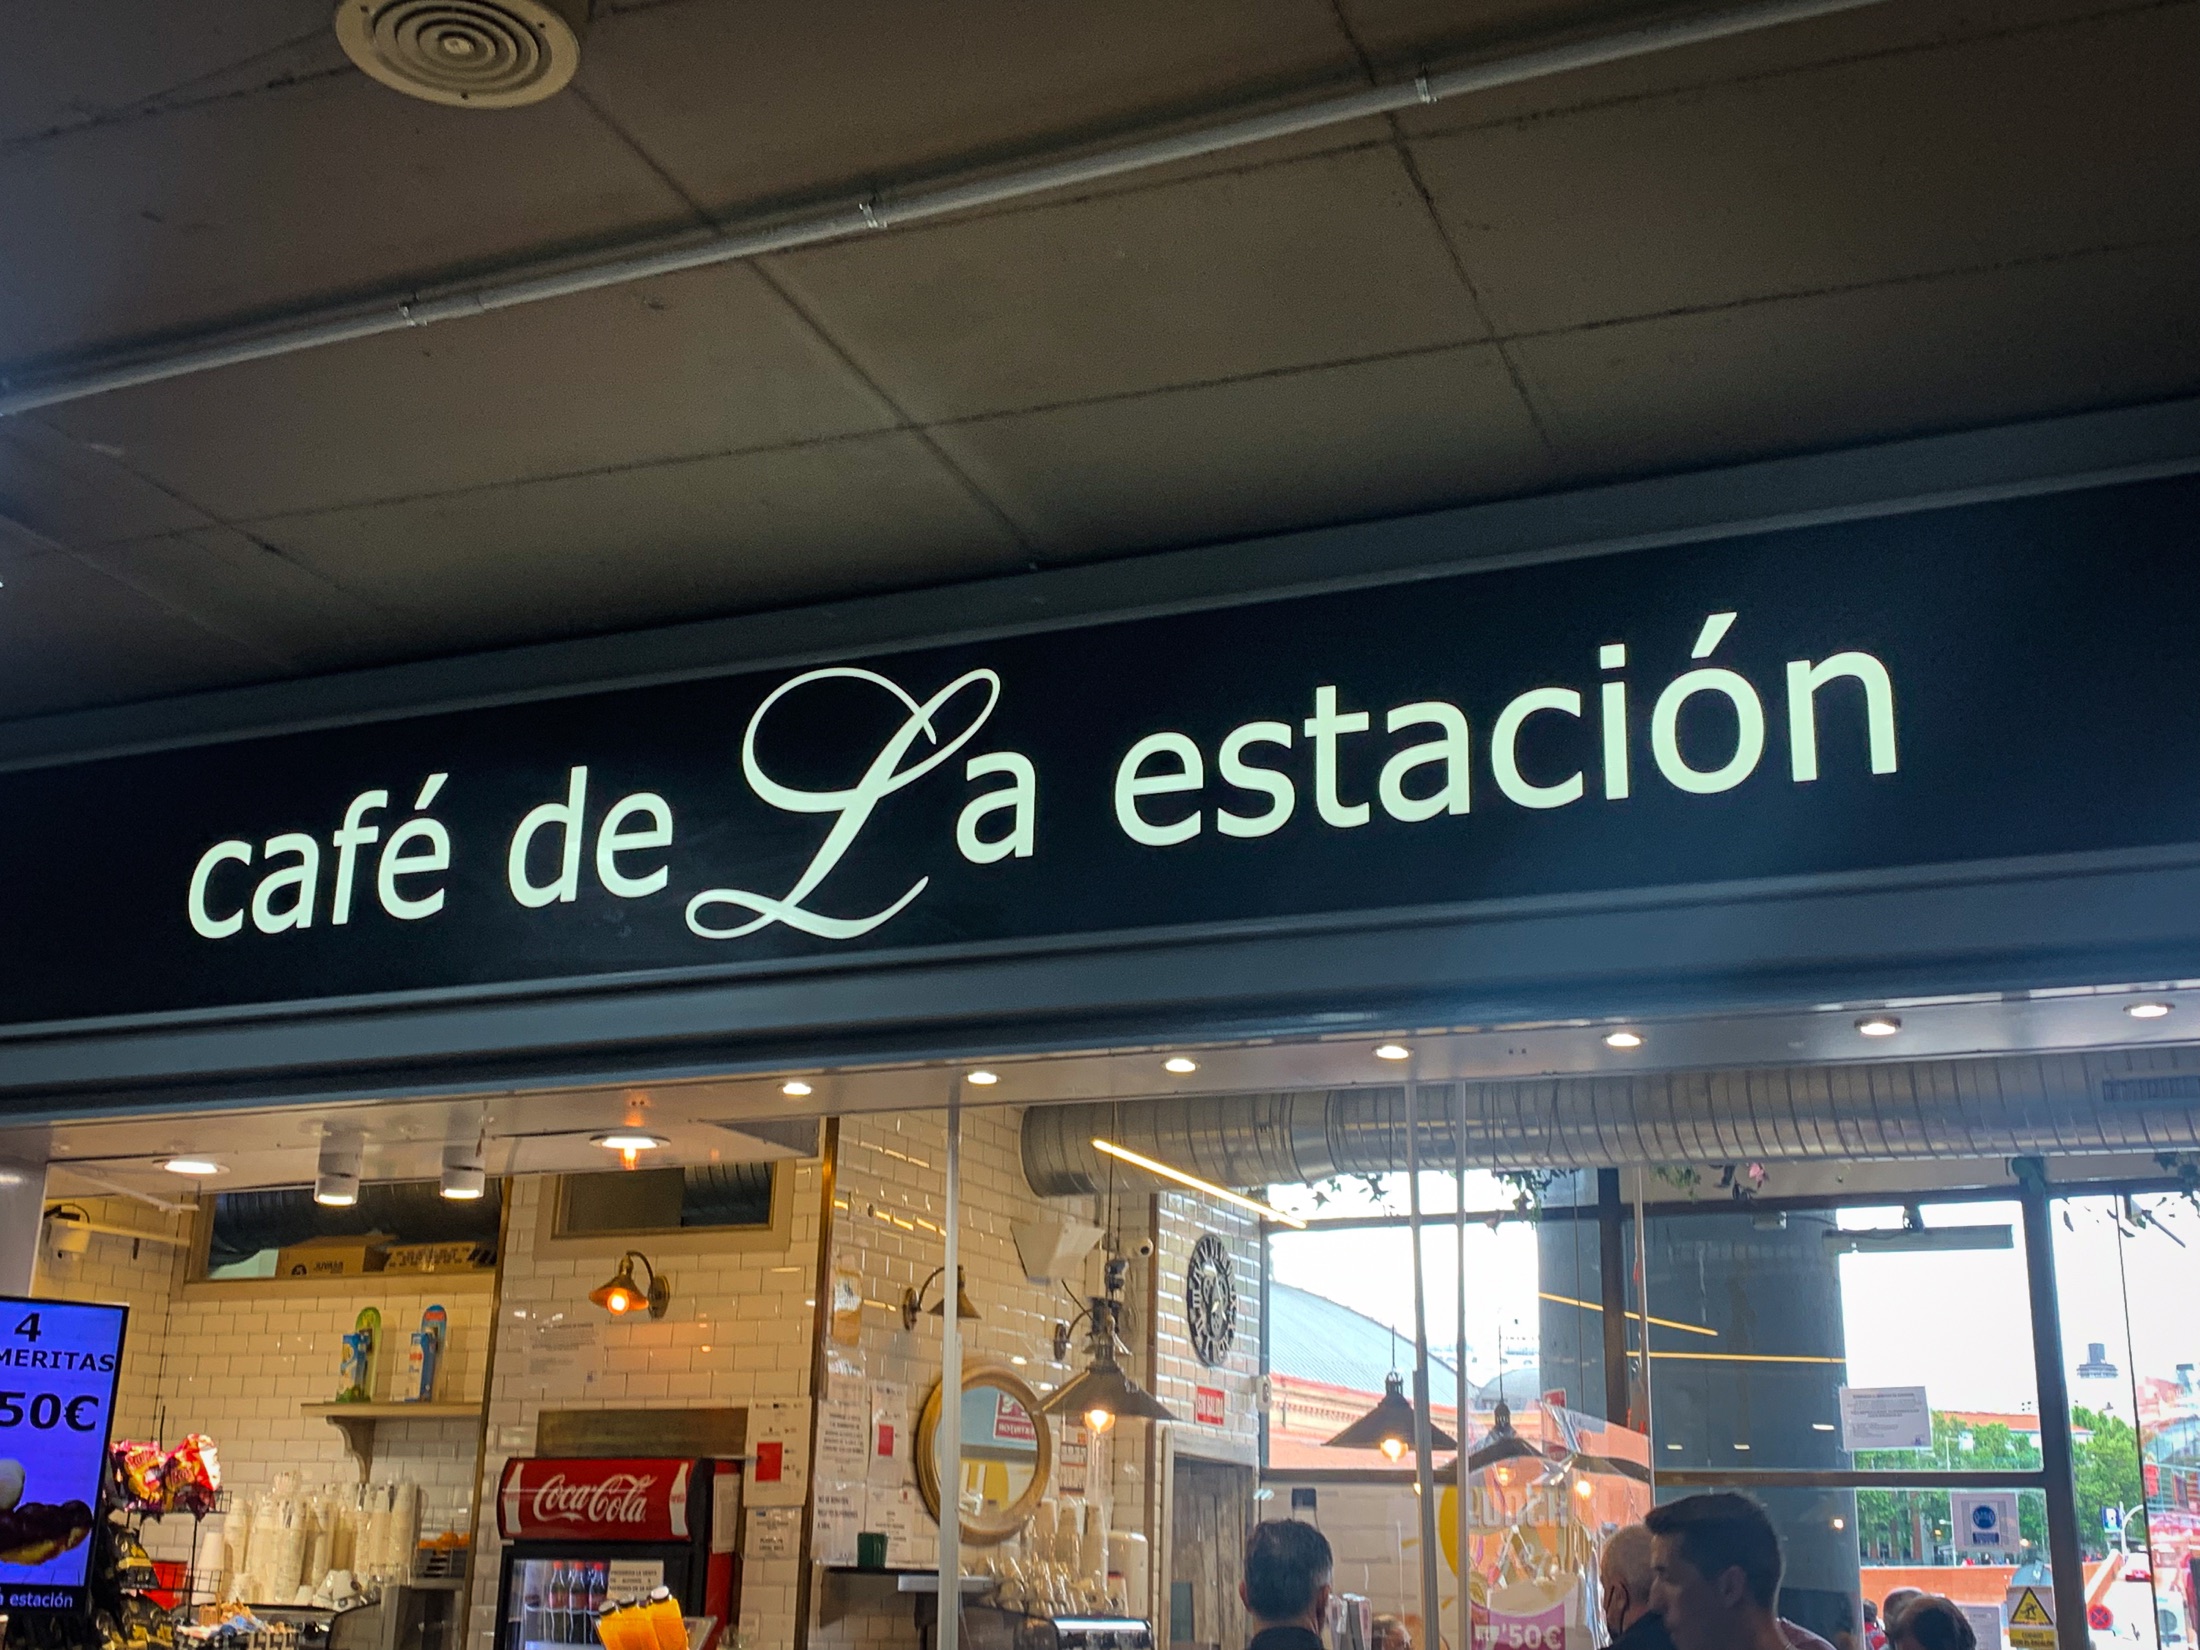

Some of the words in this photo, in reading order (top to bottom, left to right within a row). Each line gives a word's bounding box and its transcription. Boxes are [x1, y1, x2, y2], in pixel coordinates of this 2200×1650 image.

[188, 772, 450, 939] café
[508, 765, 674, 908] de
[685, 667, 1037, 939] La
[1114, 611, 1897, 846] estación
[14, 1312, 41, 1342] 4
[532, 1472, 658, 1523] Coca-Cola
[9, 1591, 73, 1608] estación
